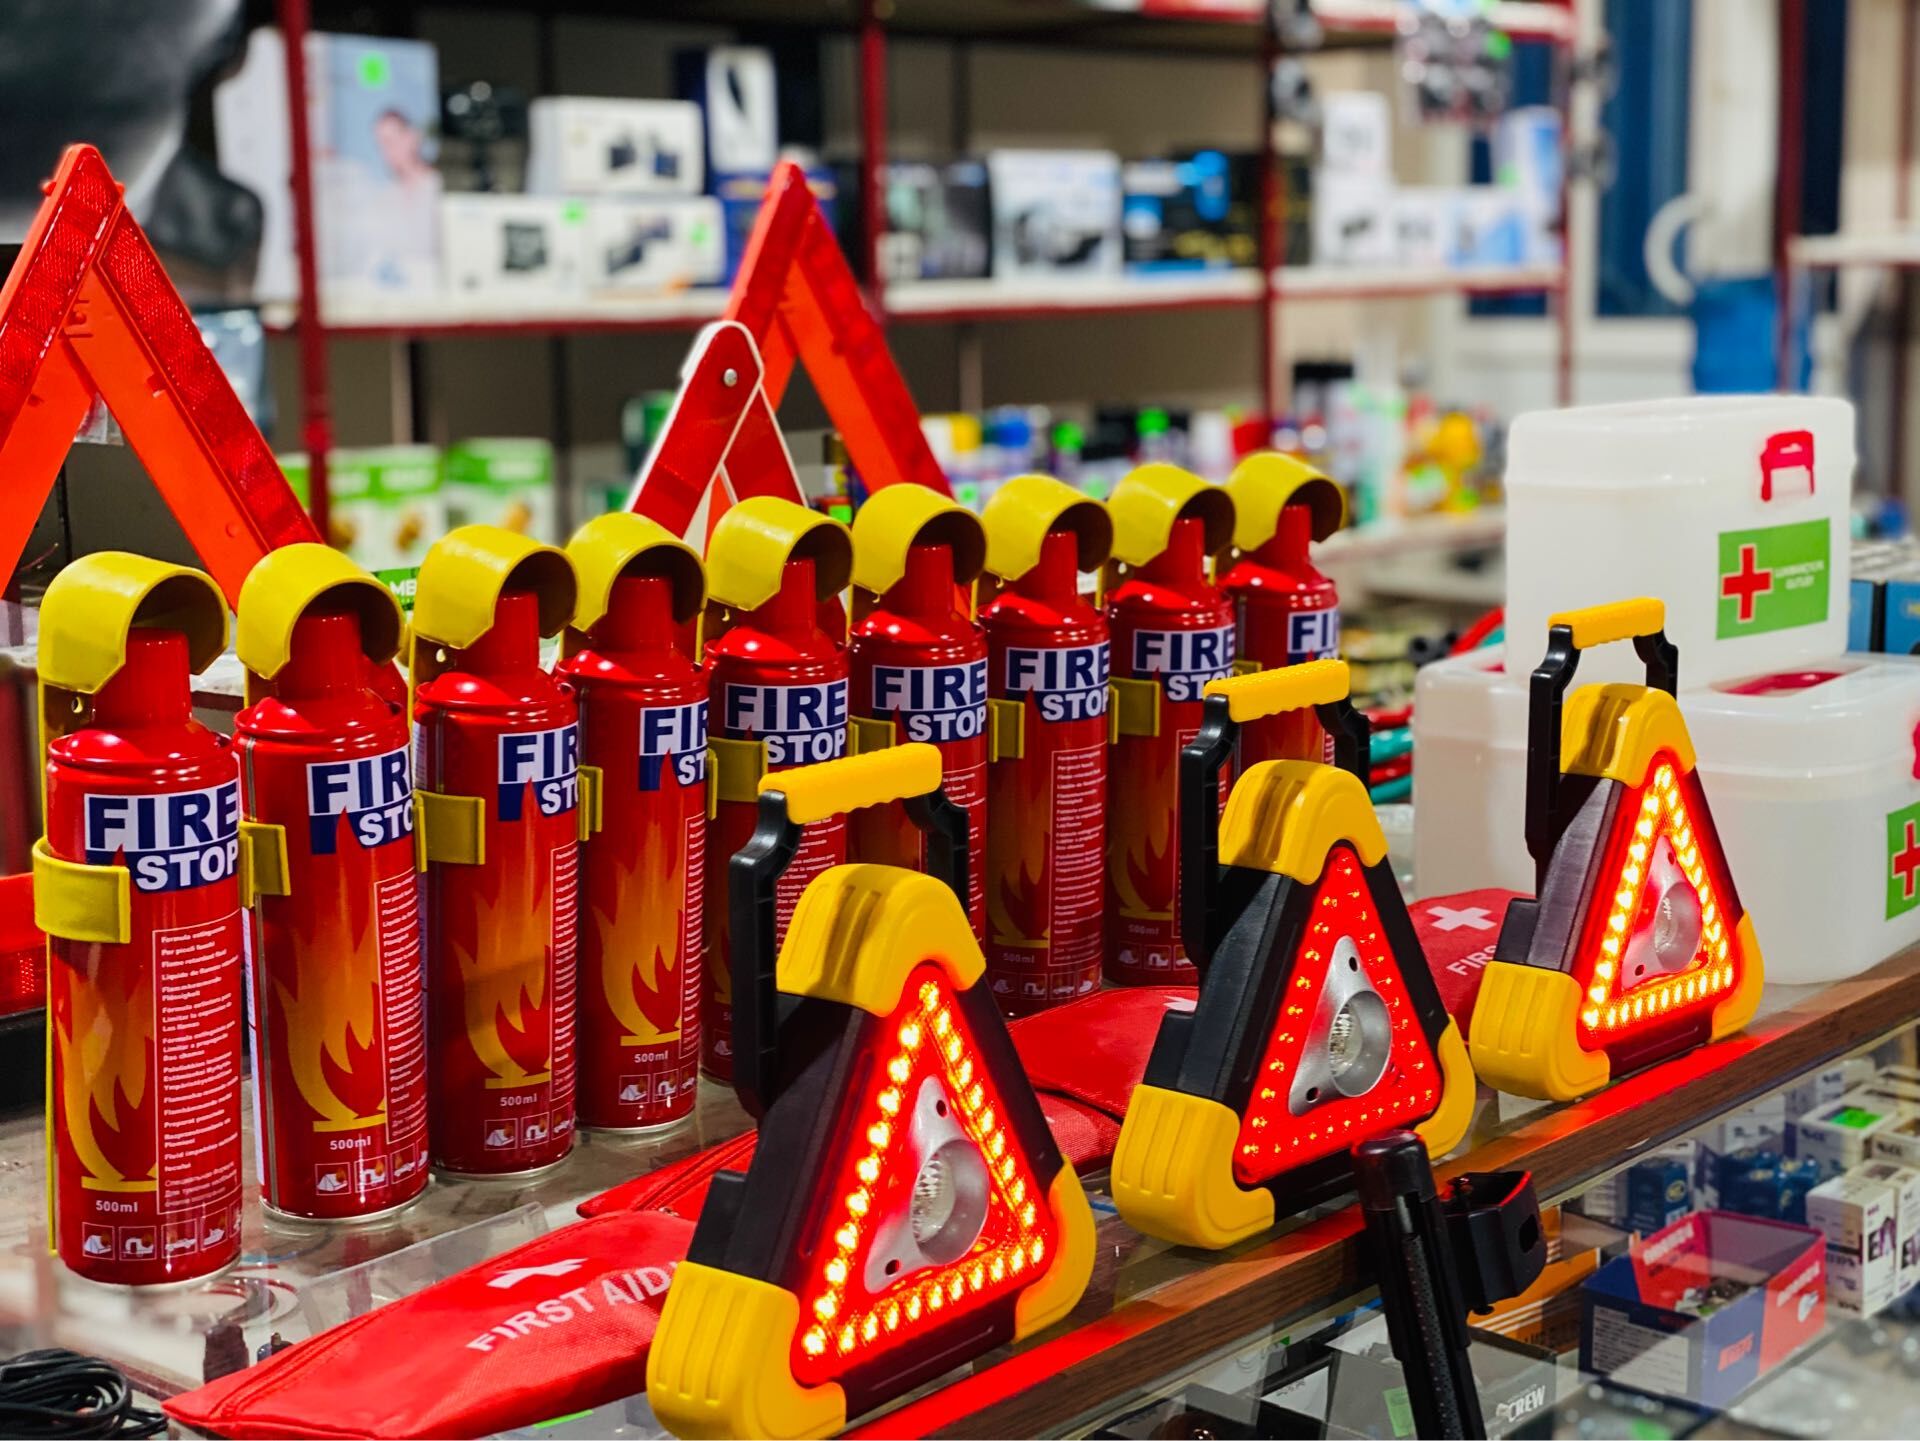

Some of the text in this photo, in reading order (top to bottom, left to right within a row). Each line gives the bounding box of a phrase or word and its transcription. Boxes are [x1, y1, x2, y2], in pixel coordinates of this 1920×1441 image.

[1136, 626, 1236, 671] FIRE
[1292, 611, 1339, 651] FI
[875, 660, 986, 709] FIRE
[1008, 643, 1110, 690] FIRE
[644, 700, 709, 754] FIR
[728, 681, 846, 730] FIRE
[908, 704, 986, 741] STOP
[503, 725, 578, 782] FIR
[678, 749, 708, 785] ST
[762, 727, 846, 764] STOP
[311, 750, 411, 814] FIR
[541, 776, 579, 814] ST
[89, 781, 238, 850] FIRE
[359, 798, 414, 846] STO
[136, 839, 239, 890] STOP
[635, 1050, 669, 1063] 500ml
[500, 1092, 538, 1107] 500ml
[330, 1135, 371, 1150] 500ml
[96, 1199, 139, 1213] 500ml
[466, 1266, 673, 1351] FIRST AID
